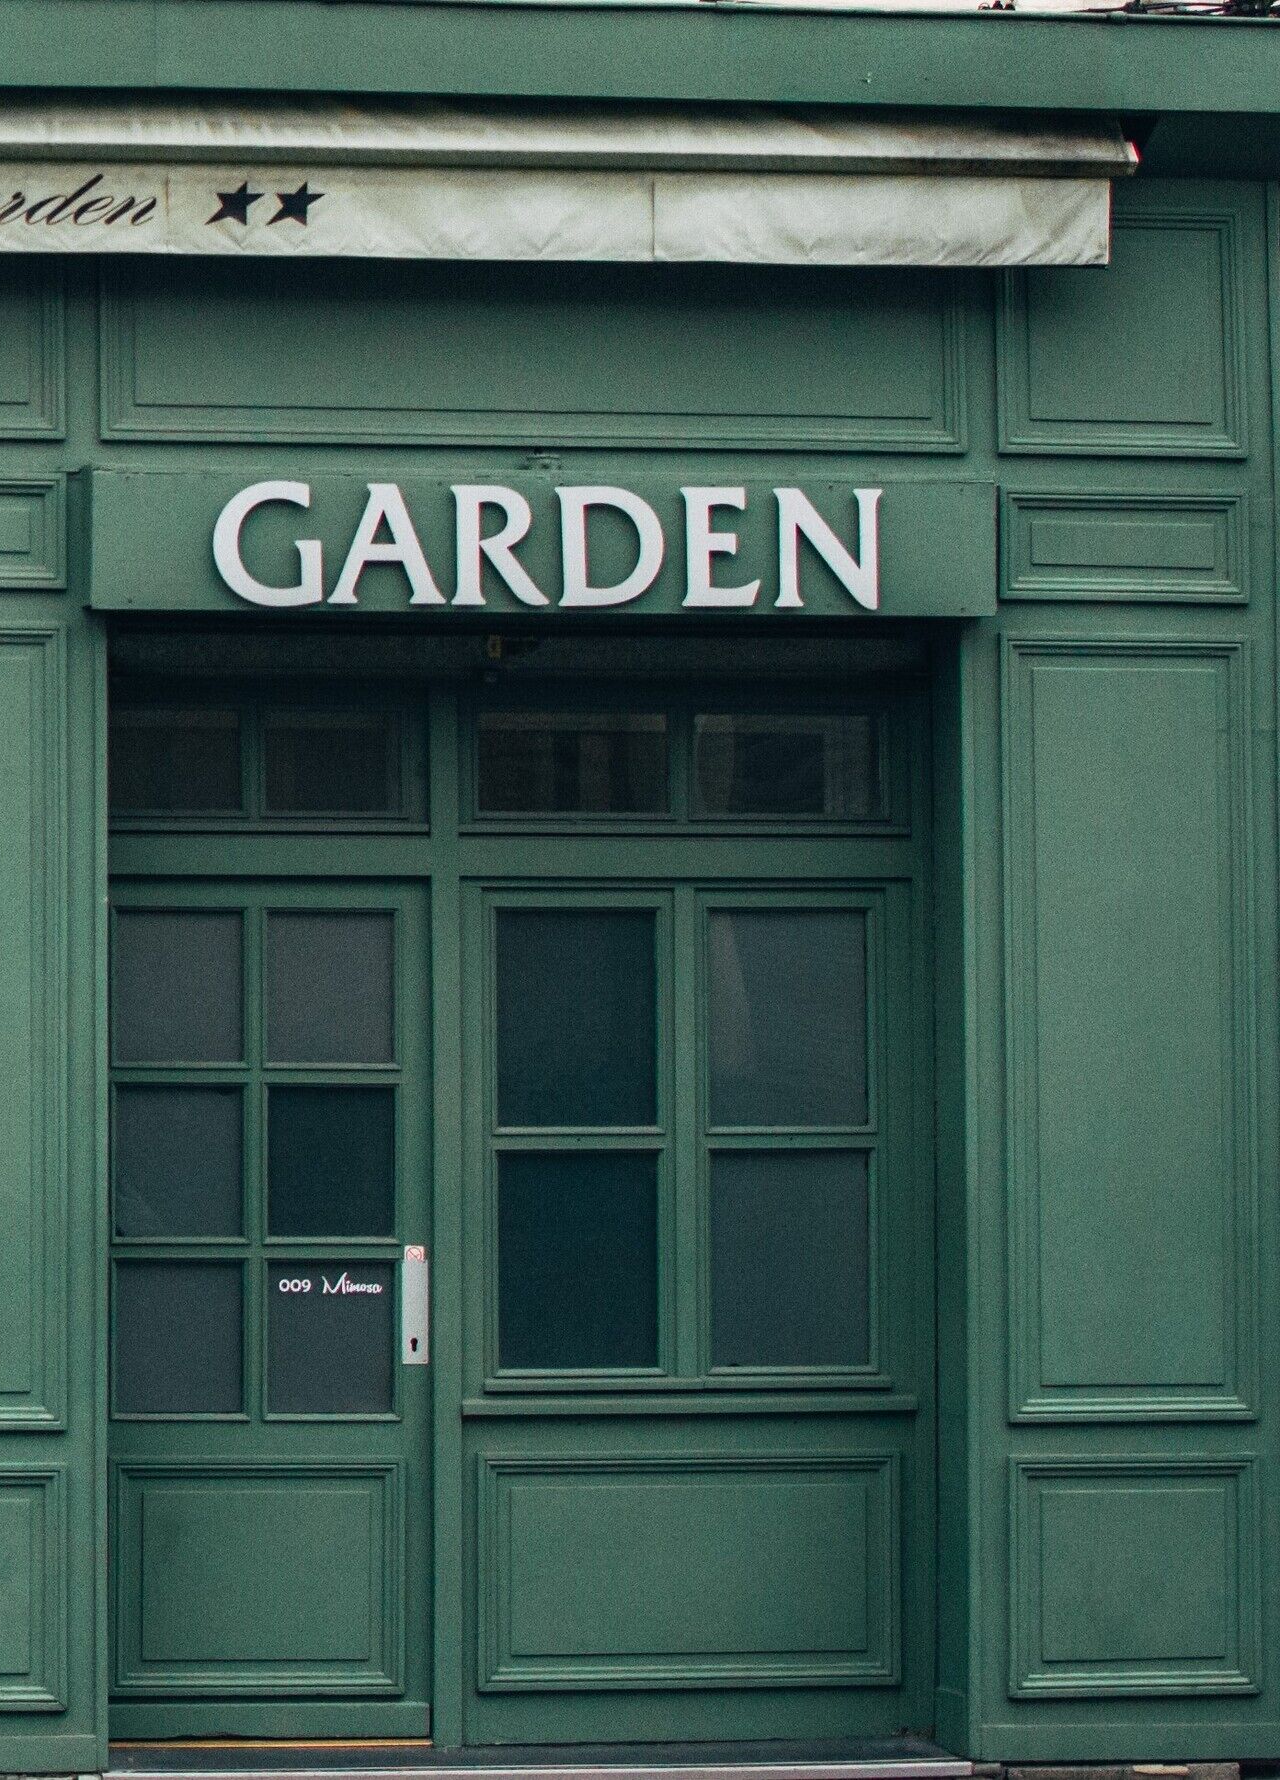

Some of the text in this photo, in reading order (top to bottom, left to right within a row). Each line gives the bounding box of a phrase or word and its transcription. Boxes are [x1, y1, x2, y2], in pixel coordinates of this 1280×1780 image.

[213, 480, 883, 610] GARDEN
[278, 1272, 383, 1295] 009 Mimosa
